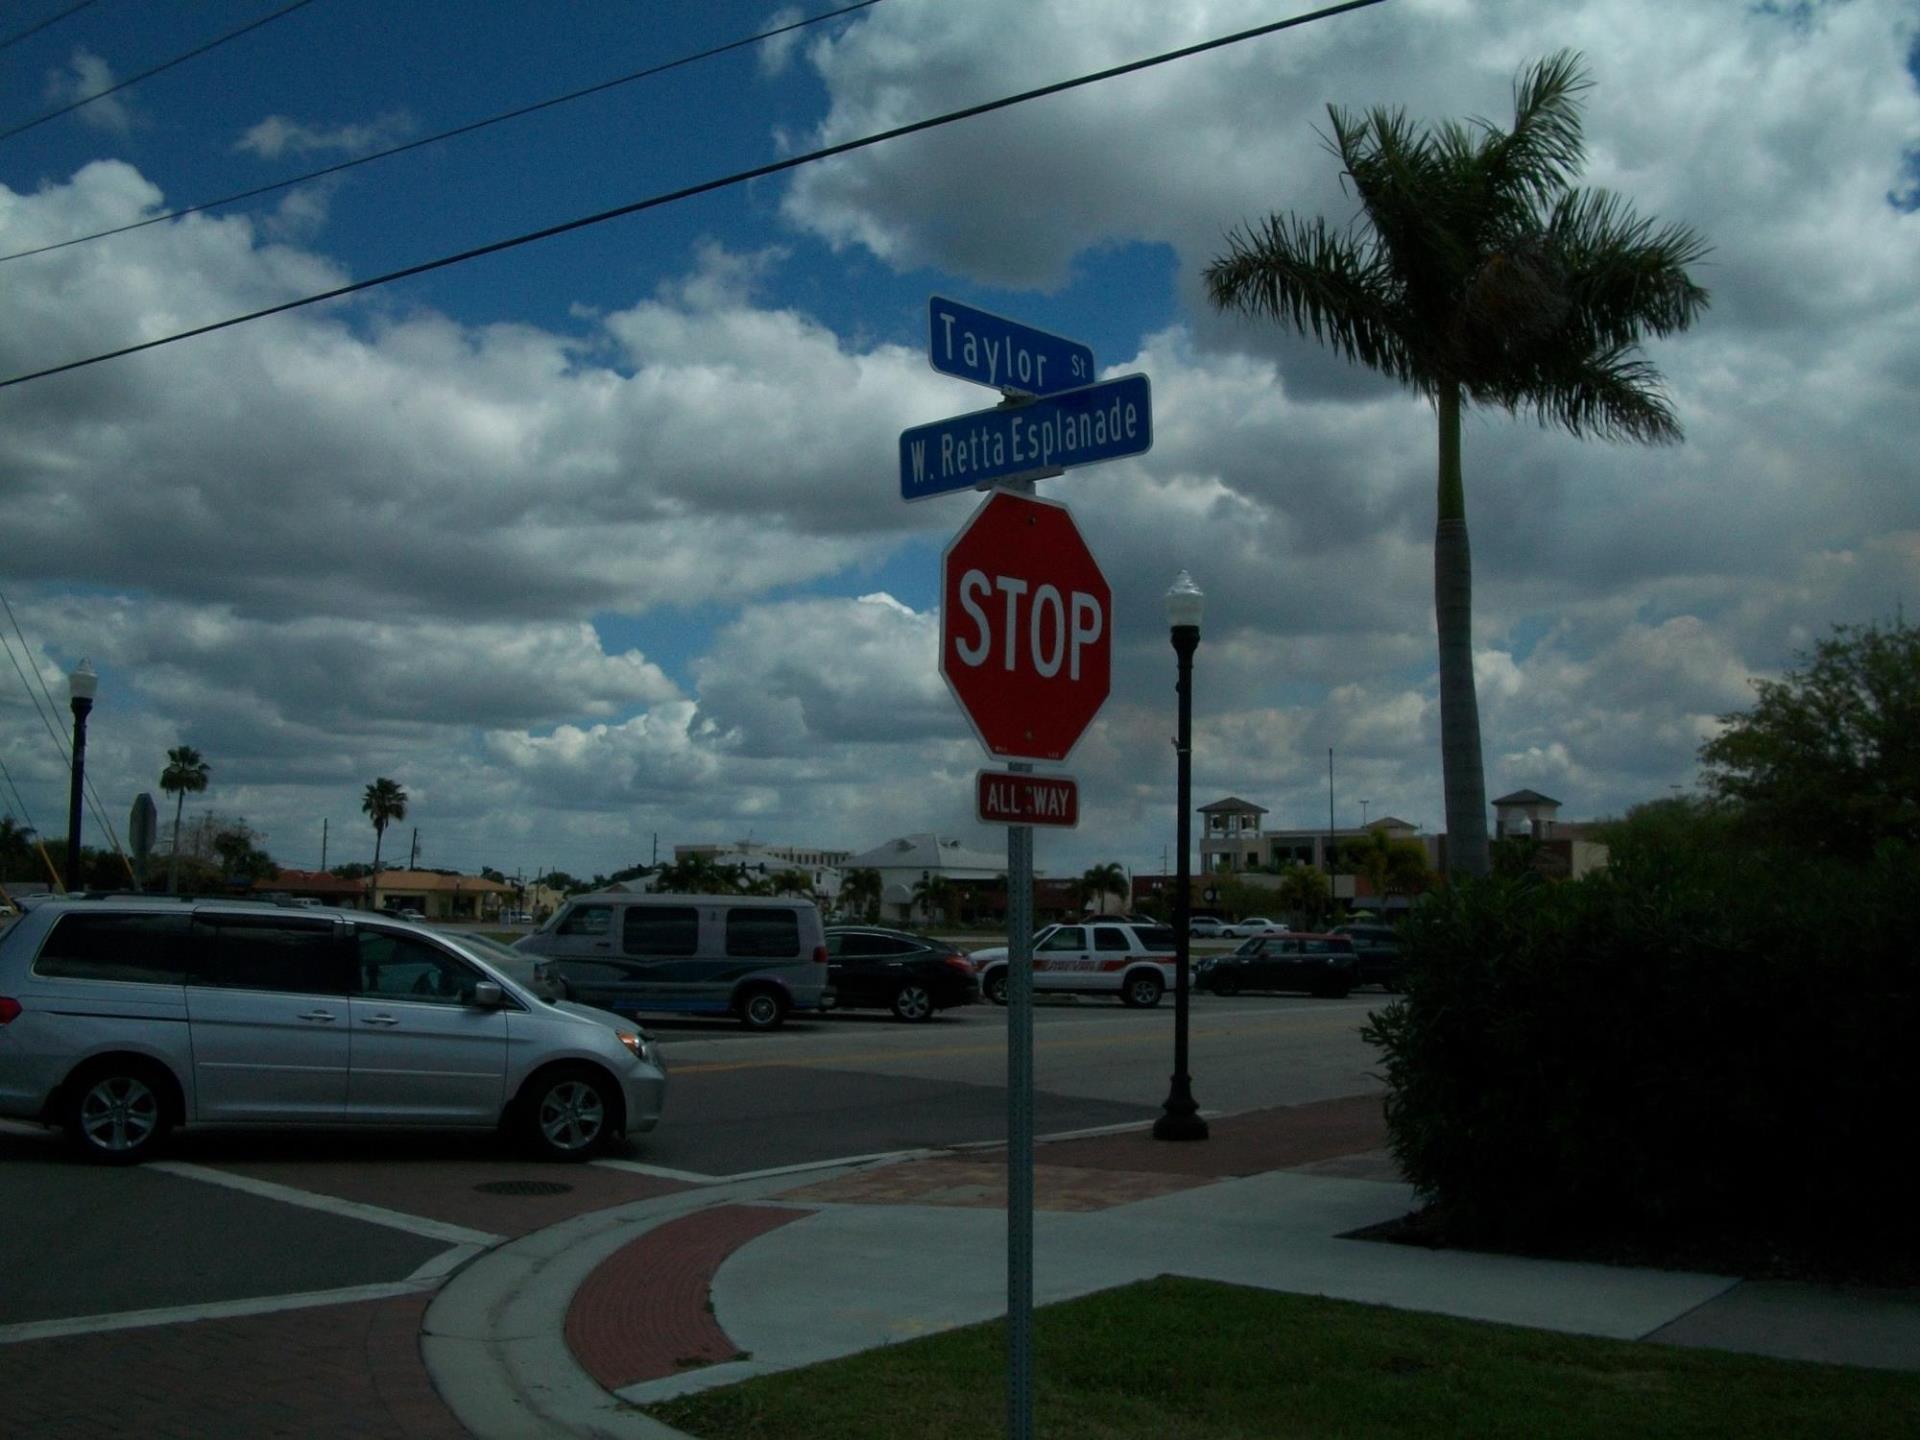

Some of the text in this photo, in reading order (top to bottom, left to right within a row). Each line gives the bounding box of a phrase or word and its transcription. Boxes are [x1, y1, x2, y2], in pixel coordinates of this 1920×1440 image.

[939, 312, 1087, 387] Taylor St
[910, 397, 1138, 484] W. Retta Esplanade
[955, 568, 1104, 682] STOP
[986, 782, 1070, 817] ALL WAY
